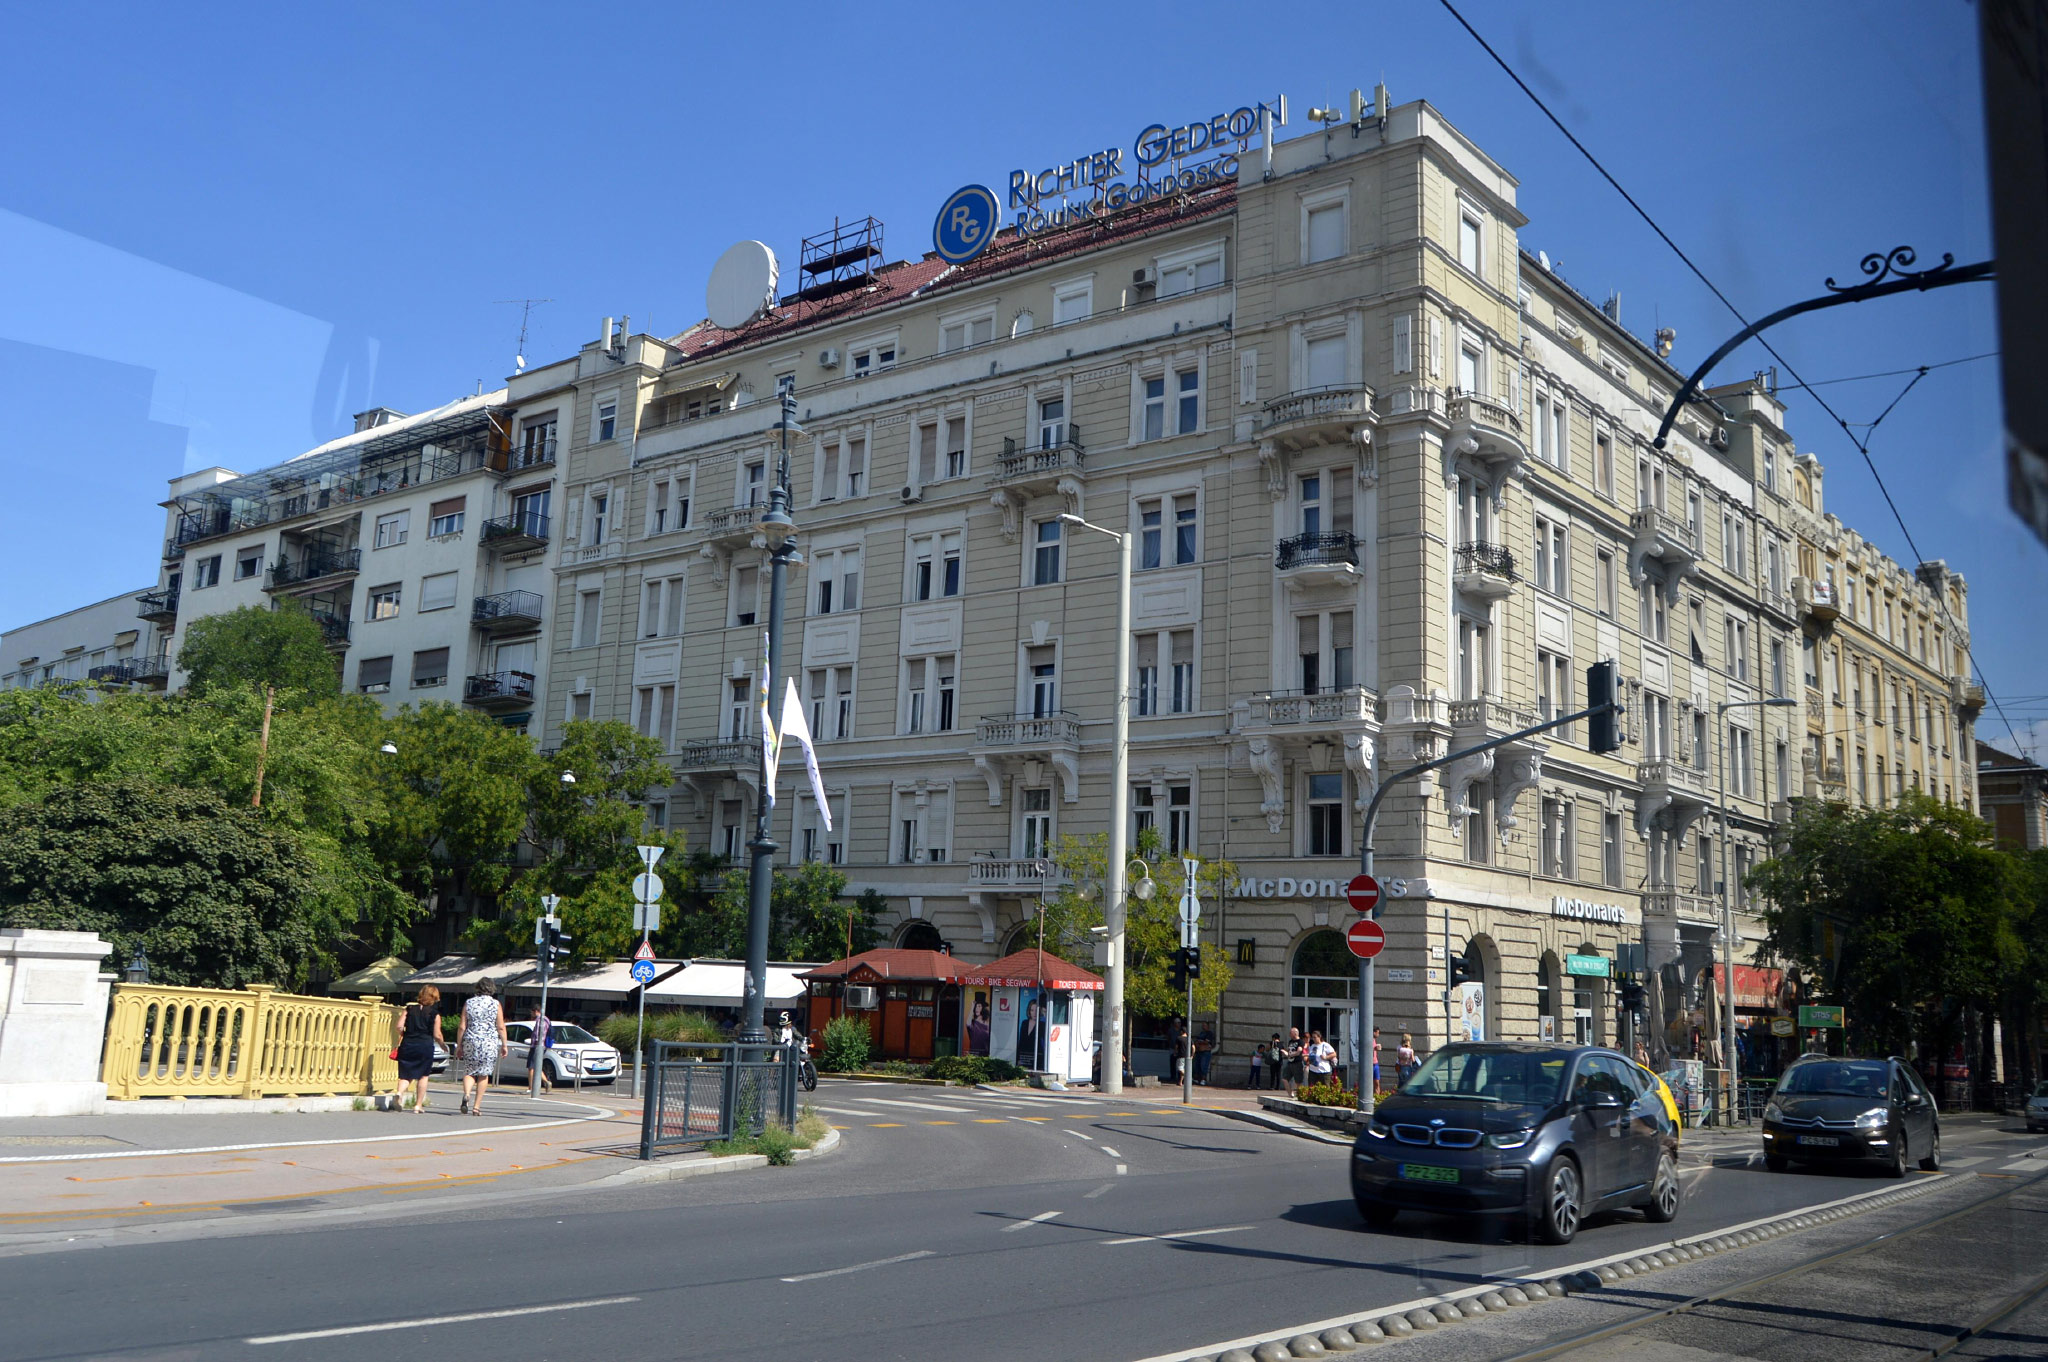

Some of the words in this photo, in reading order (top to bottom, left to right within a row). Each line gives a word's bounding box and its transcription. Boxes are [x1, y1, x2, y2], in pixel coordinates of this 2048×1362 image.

[1008, 147, 1124, 209] RICHTER
[1134, 94, 1288, 167] GEDEON
[1233, 876, 1408, 898] McDona's
[1555, 895, 1626, 923] McDonald's
[964, 977, 985, 986] TOURS
[988, 978, 1002, 987] BIKE
[1005, 979, 1031, 988] SEGWAY
[1058, 980, 1077, 989] TICKETS
[1079, 981, 1094, 990] TOURS
